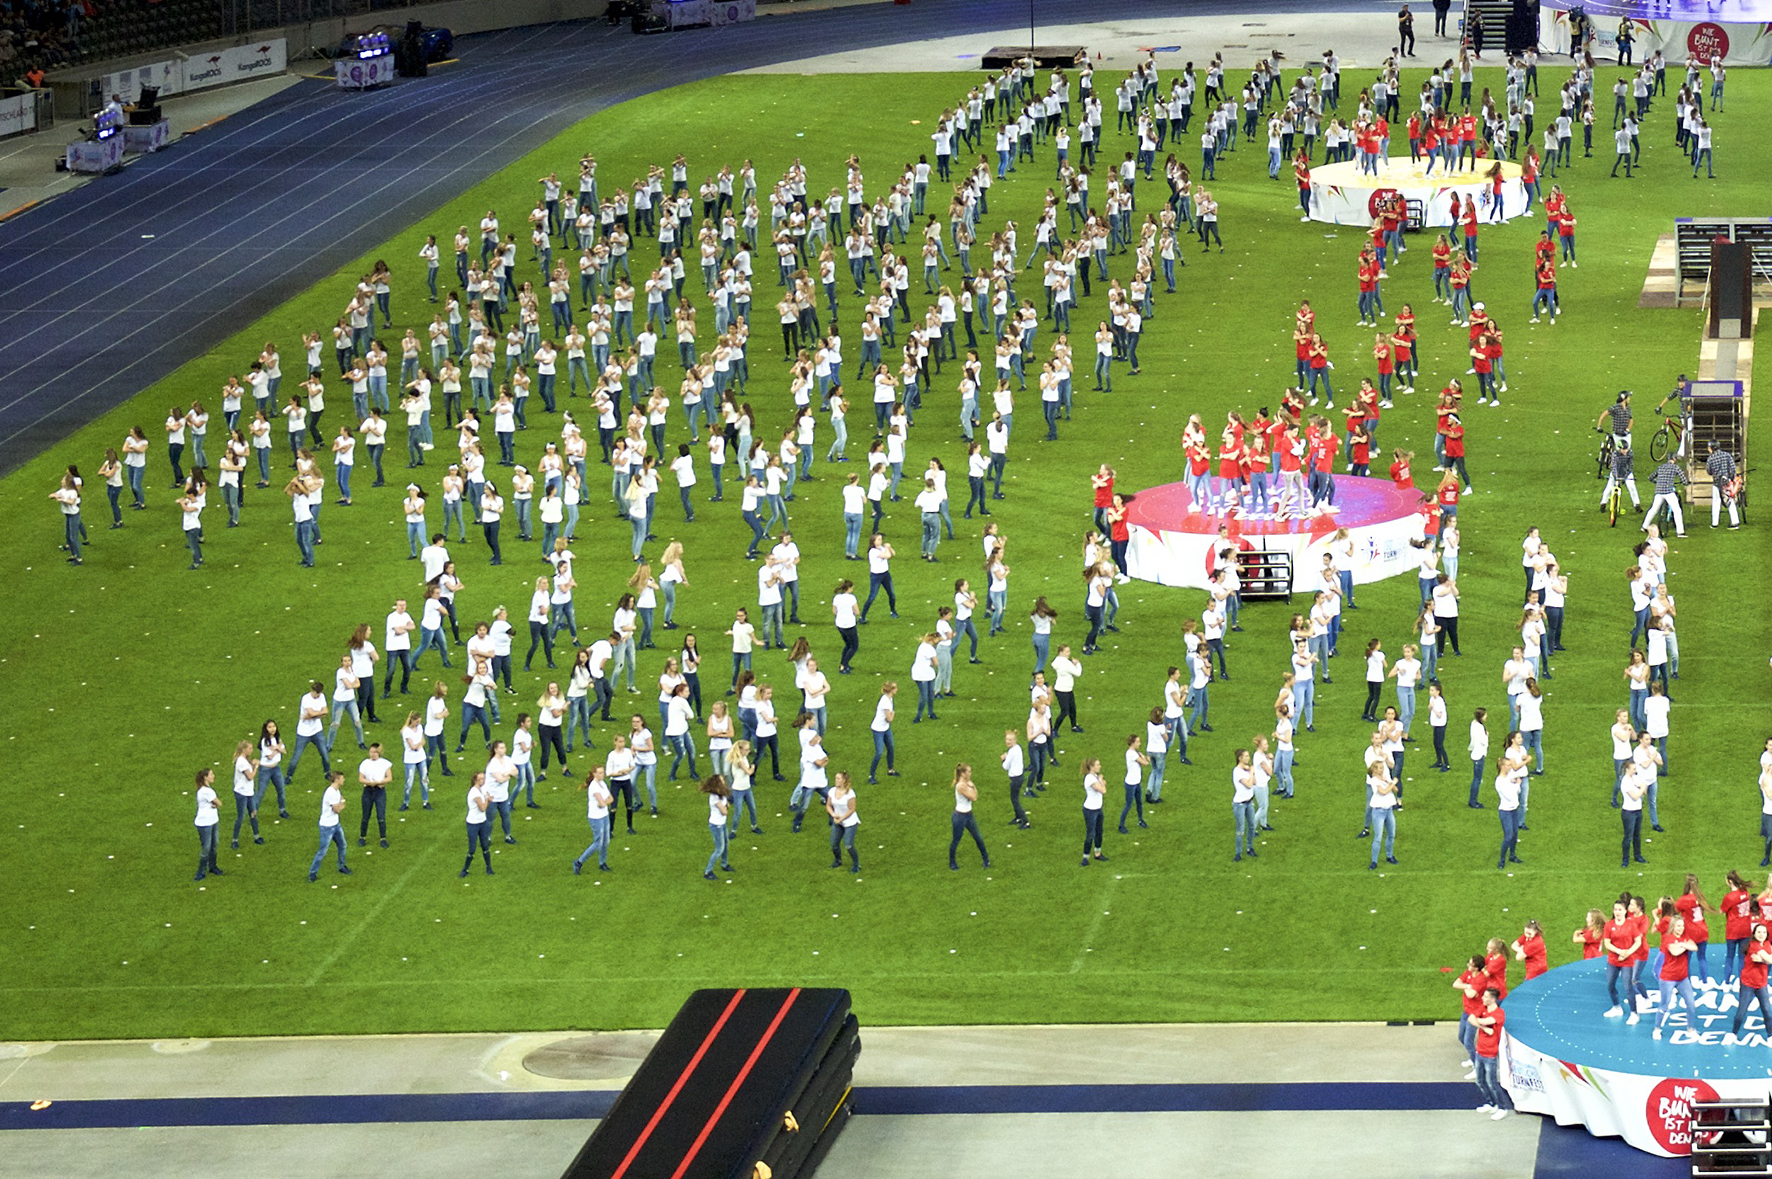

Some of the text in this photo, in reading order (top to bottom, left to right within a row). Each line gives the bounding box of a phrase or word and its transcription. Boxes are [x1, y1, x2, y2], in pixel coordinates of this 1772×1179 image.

[1694, 34, 1720, 47] BUNT
[237, 57, 272, 71] KangaROOS
[189, 68, 222, 82] KangaROOS
[1674, 1085, 1698, 1101] WIE
[1665, 1117, 1685, 1131] IST
